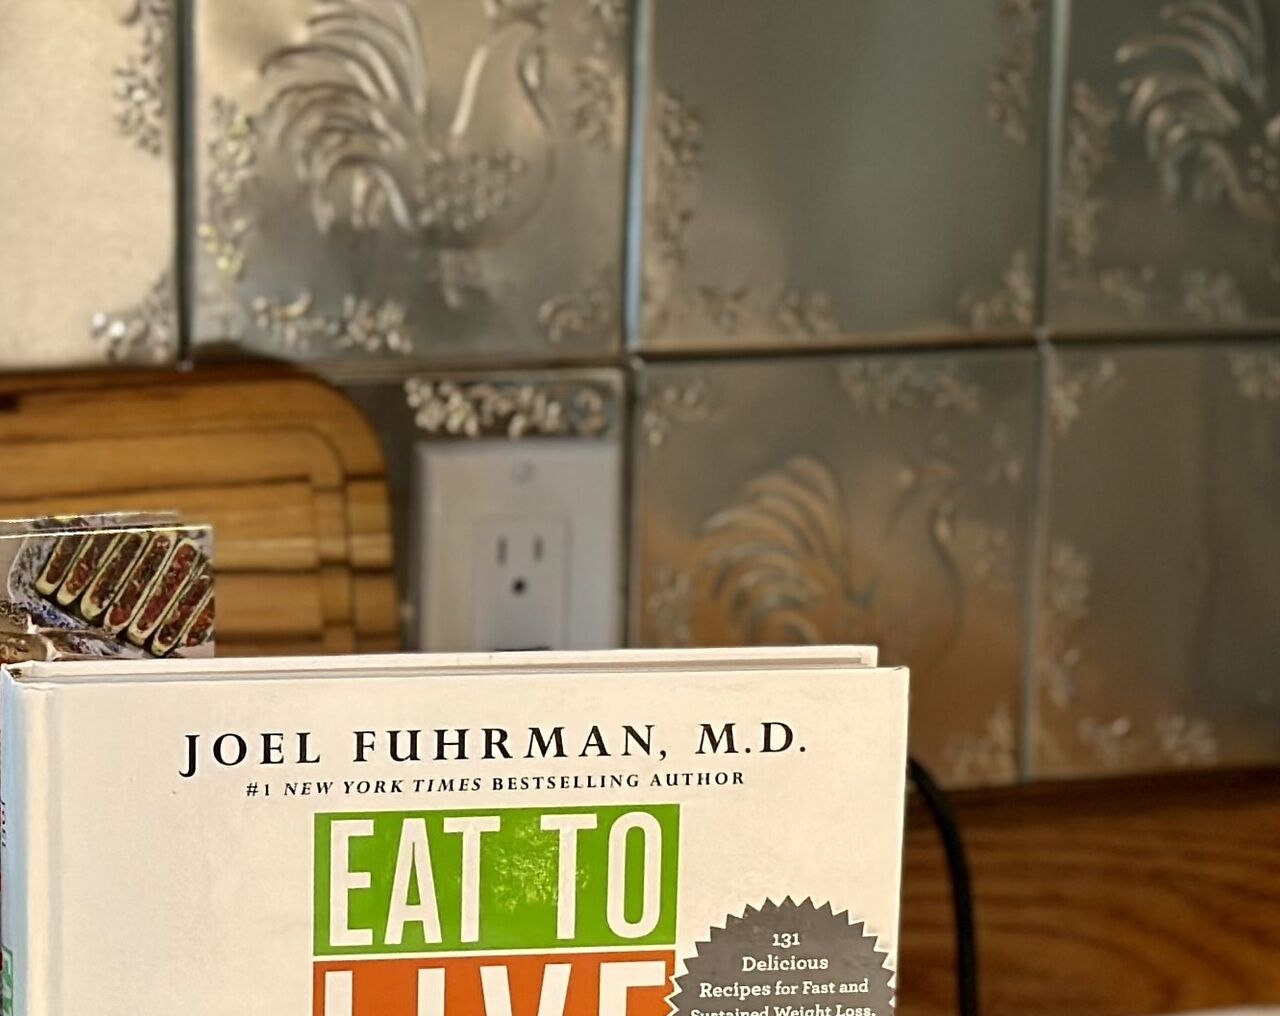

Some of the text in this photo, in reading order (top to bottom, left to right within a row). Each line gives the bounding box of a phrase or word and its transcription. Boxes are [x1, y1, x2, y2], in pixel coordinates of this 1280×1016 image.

[178, 721, 806, 778] JOEL FUHRMAN, M.D.
[246, 771, 744, 797] #1 NEW YORK TIMES BESTSELLING AUTHOR
[329, 811, 662, 946] EAT TO
[772, 933, 800, 948] 131
[742, 954, 829, 972] Delicious
[699, 978, 869, 1000] Recipes for Fast and
